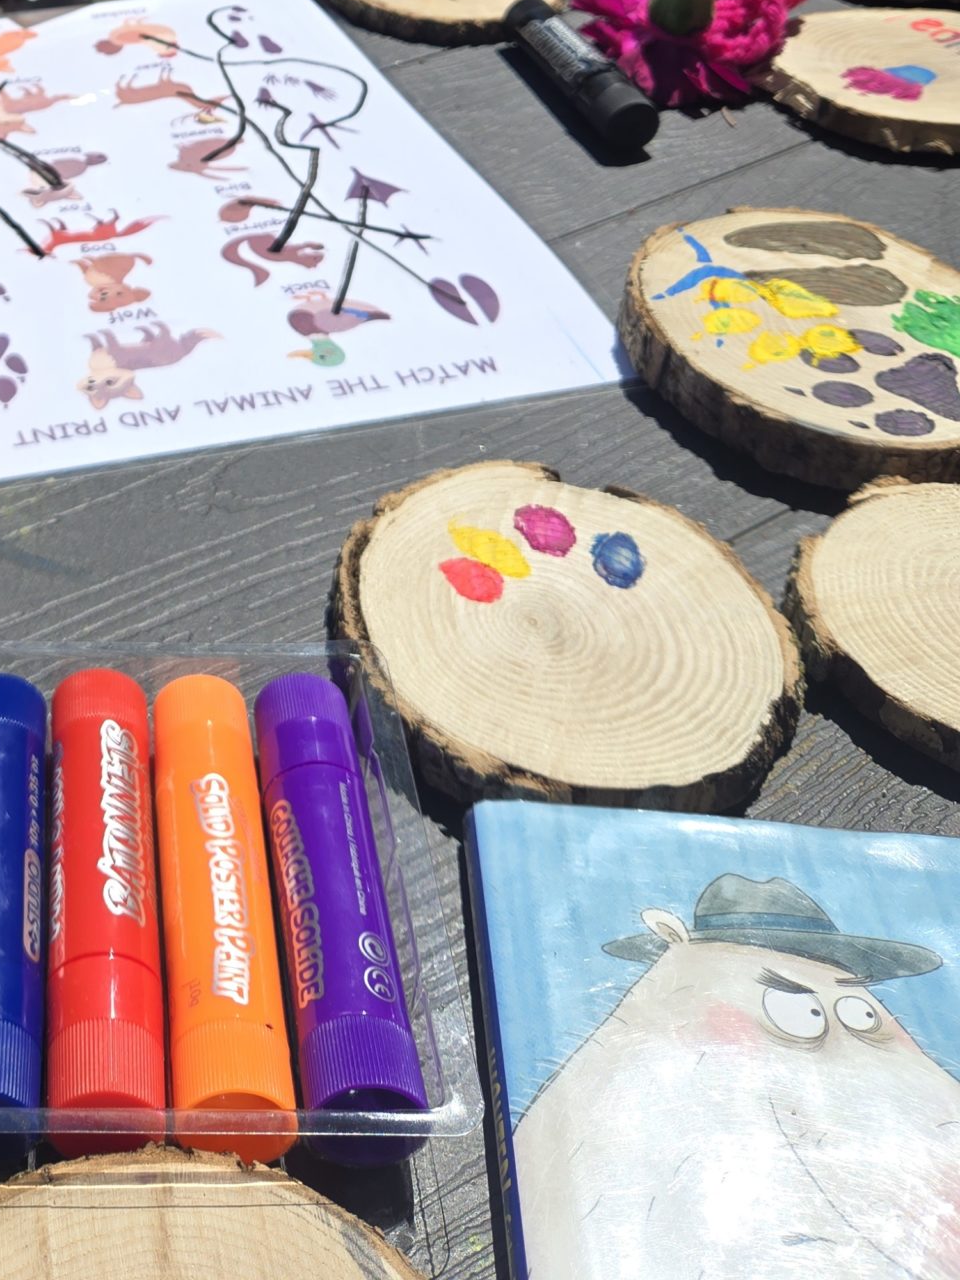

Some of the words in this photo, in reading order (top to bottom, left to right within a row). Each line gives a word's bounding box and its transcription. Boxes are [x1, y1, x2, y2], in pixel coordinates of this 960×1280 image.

[59, 203, 93, 213] Fox
[223, 218, 290, 235] quirrel
[80, 243, 117, 254] Dog
[281, 279, 331, 294] Duck
[109, 306, 158, 324] Wolf
[400, 355, 498, 387] MATCH
[331, 374, 390, 399] THE
[193, 382, 313, 417] ANIMAL
[118, 403, 181, 428] AND
[13, 416, 108, 447] PRINT
[269, 798, 315, 911] GOUACHE
